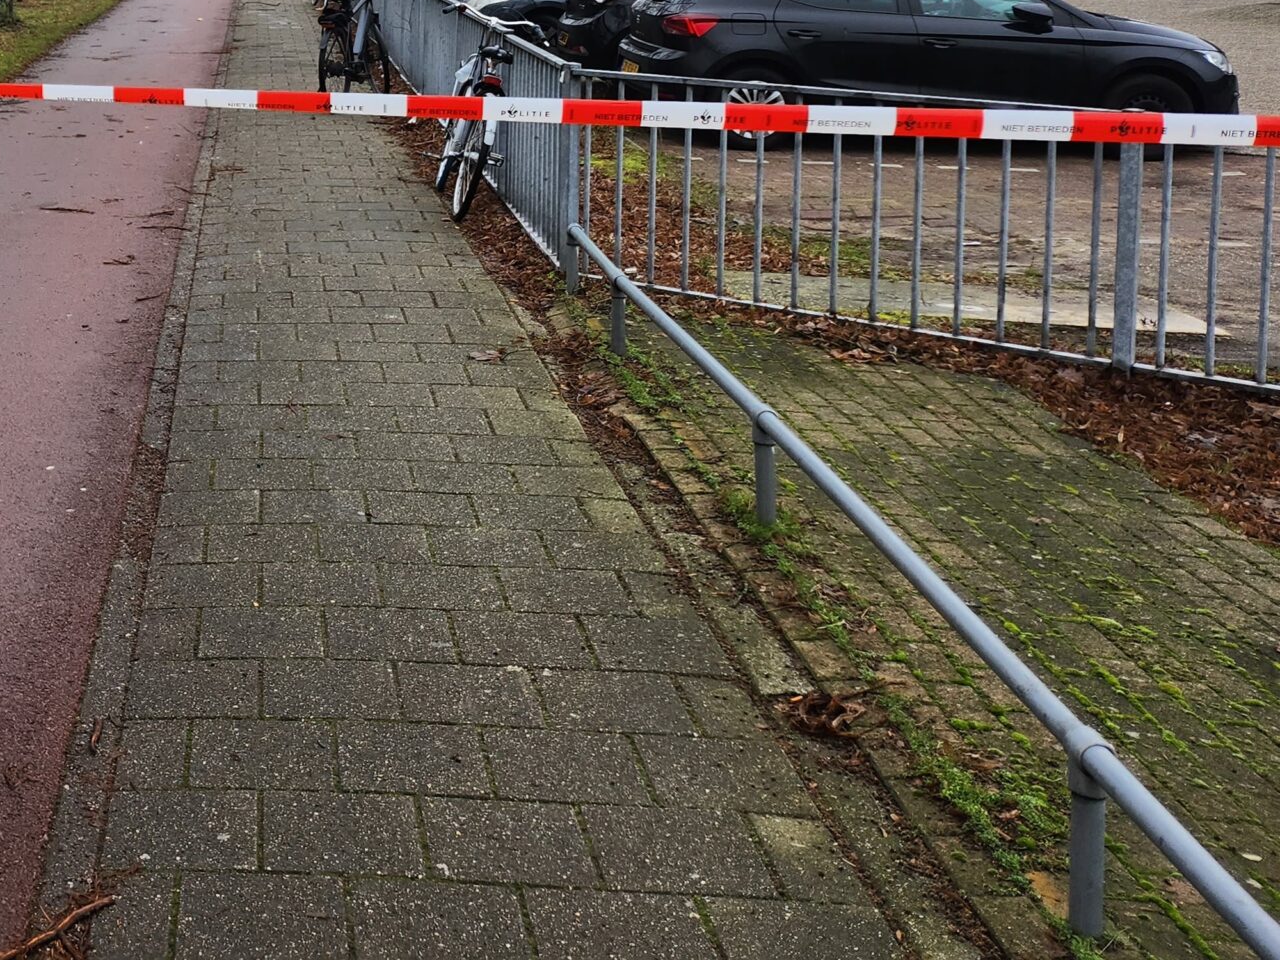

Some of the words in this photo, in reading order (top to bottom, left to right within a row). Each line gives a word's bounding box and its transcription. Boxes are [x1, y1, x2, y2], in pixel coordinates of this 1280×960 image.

[429, 108, 478, 116] BETREDEN
[500, 107, 551, 118] POLITIE
[617, 113, 669, 122] BETREDEN
[693, 112, 746, 124] POLITIE
[817, 120, 872, 128] BETREDEN
[896, 119, 953, 130] POLITIE
[1001, 124, 1024, 132] NIET
[1026, 125, 1084, 134] BETREDEN
[1110, 123, 1167, 136] POLITIE
[1220, 130, 1245, 138] NIET
